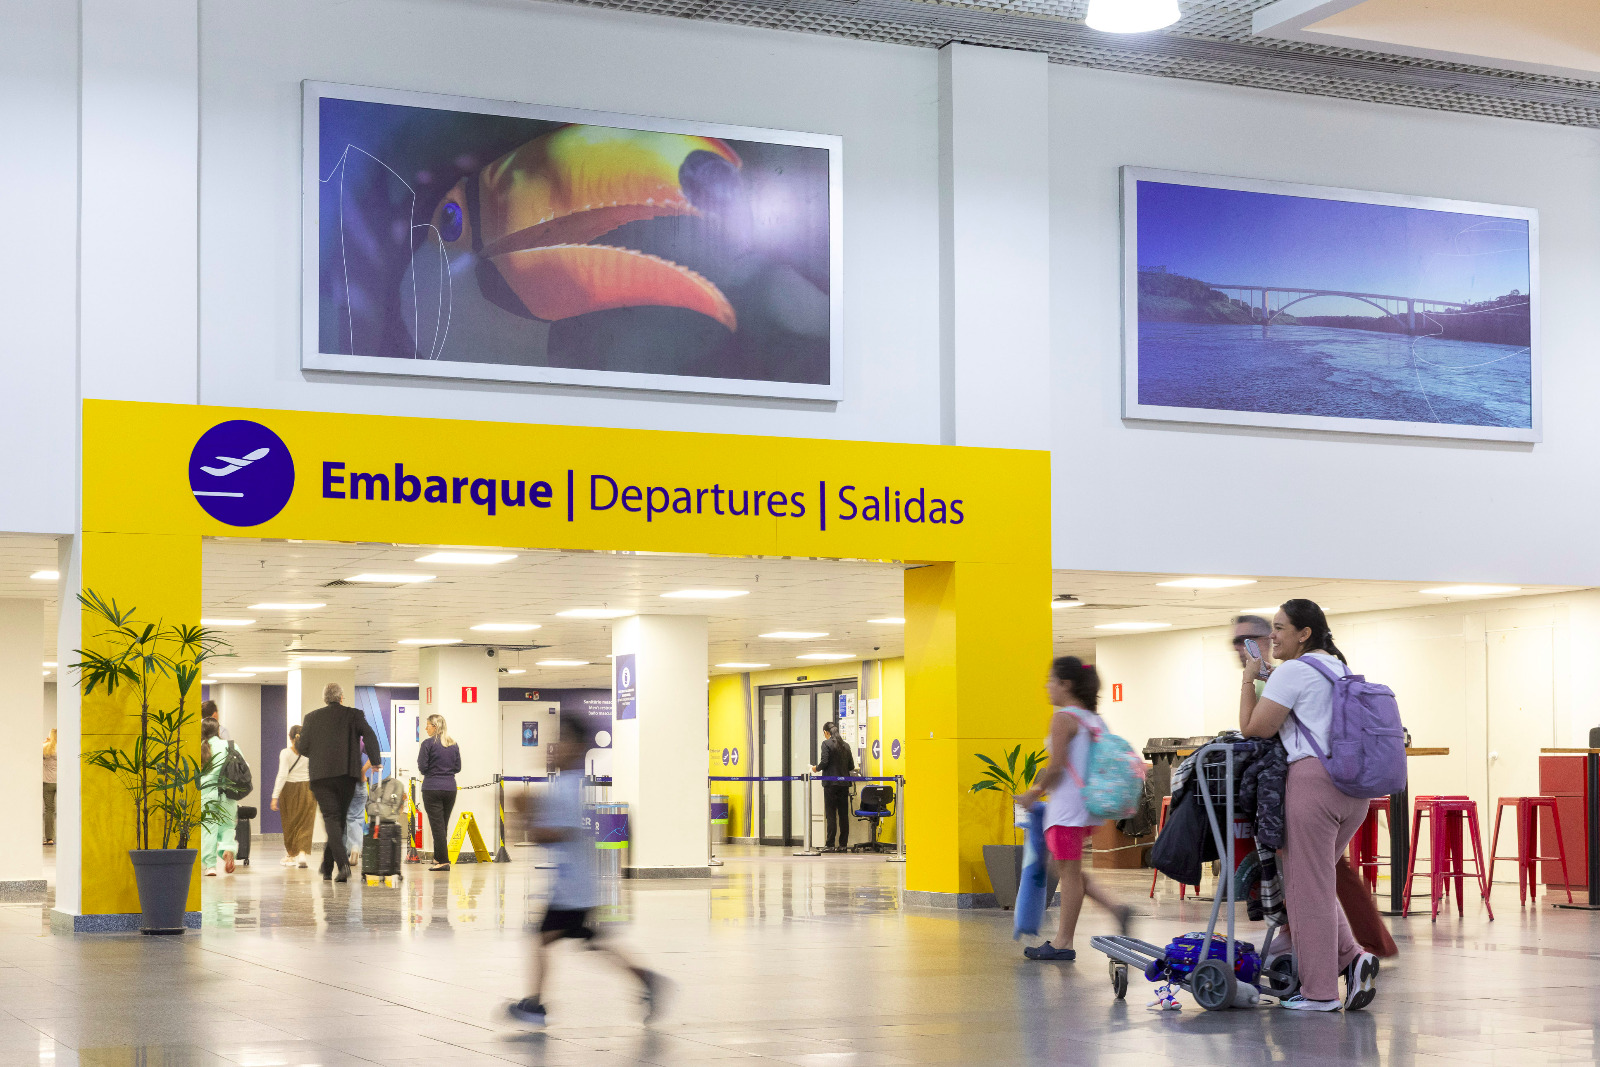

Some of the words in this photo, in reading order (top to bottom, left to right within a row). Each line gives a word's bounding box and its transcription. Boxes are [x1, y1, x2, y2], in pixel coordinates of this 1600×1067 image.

[322, 461, 553, 516] Embarque
[590, 474, 806, 522] Departures
[838, 485, 964, 524] Salidas
